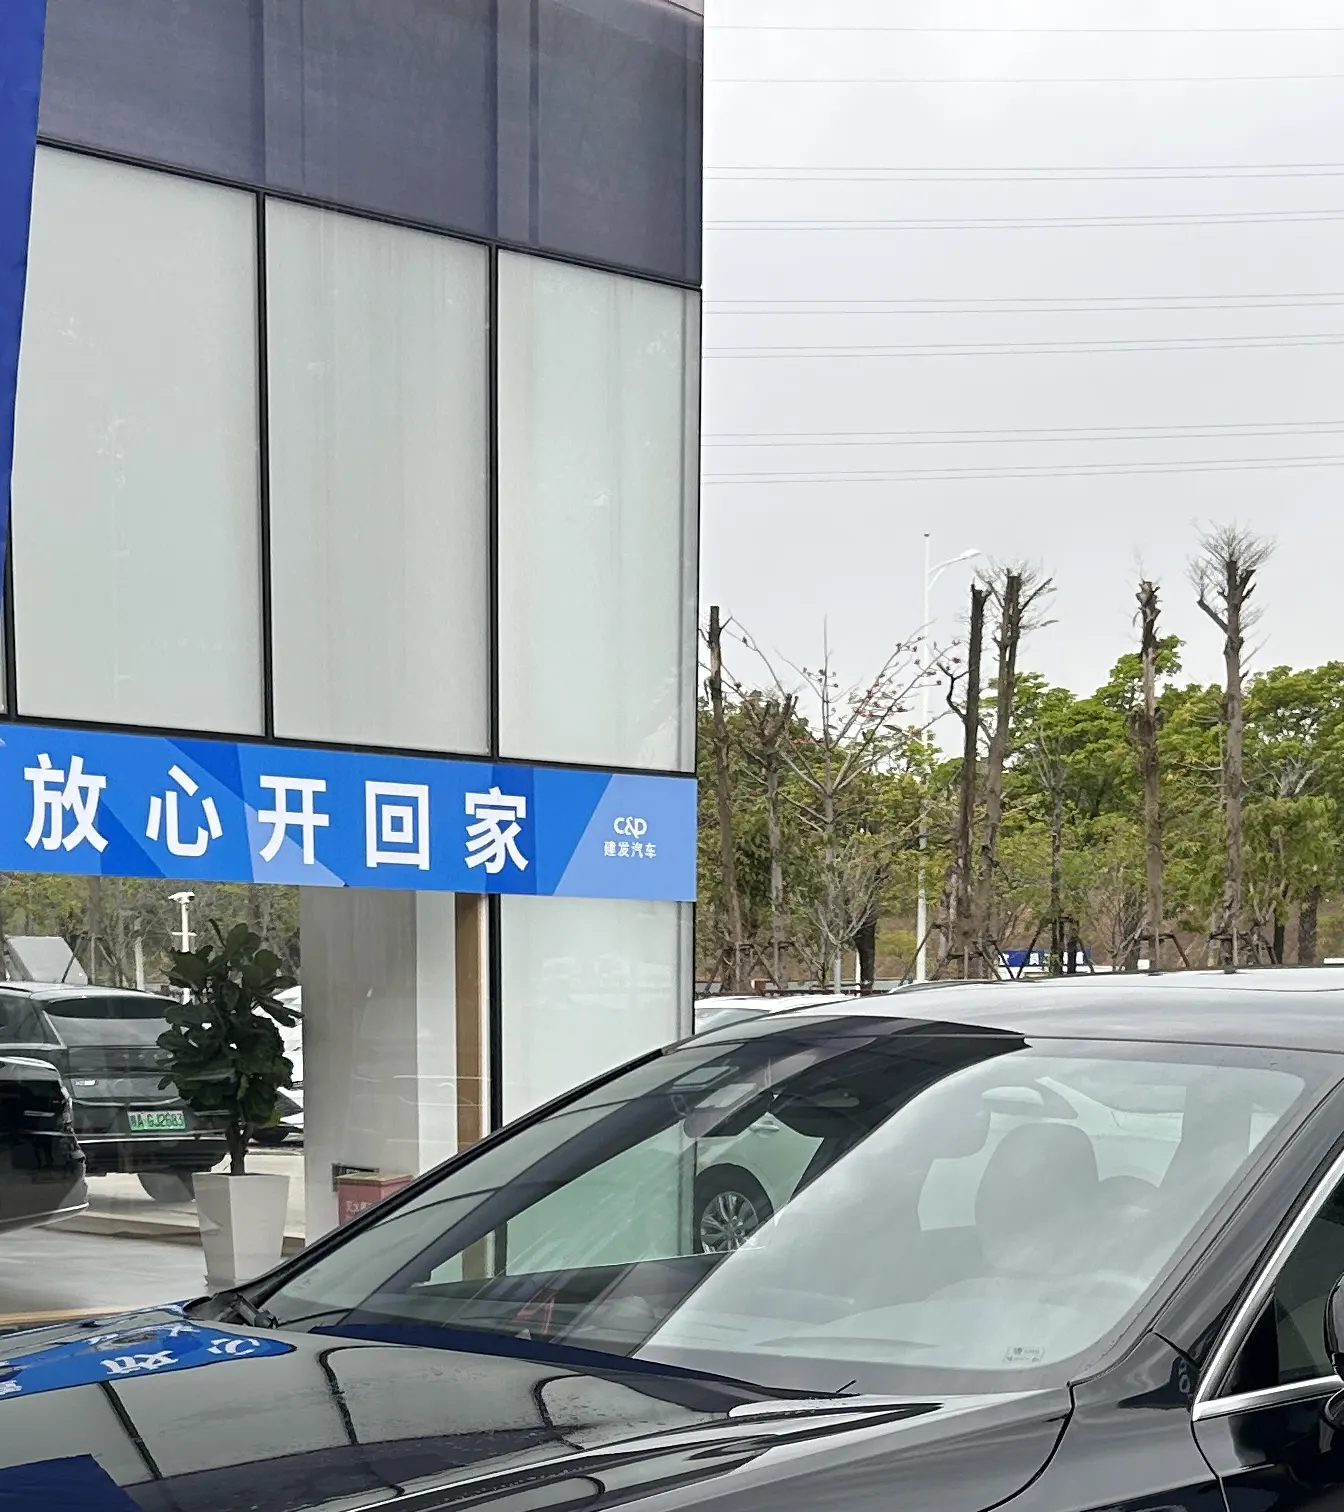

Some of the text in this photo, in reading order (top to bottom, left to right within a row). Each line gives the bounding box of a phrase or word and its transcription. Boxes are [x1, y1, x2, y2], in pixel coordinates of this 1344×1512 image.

[23, 752, 530, 875] 放心开回家
[613, 816, 648, 839] C&D
[603, 840, 657, 859] 建发汽车
